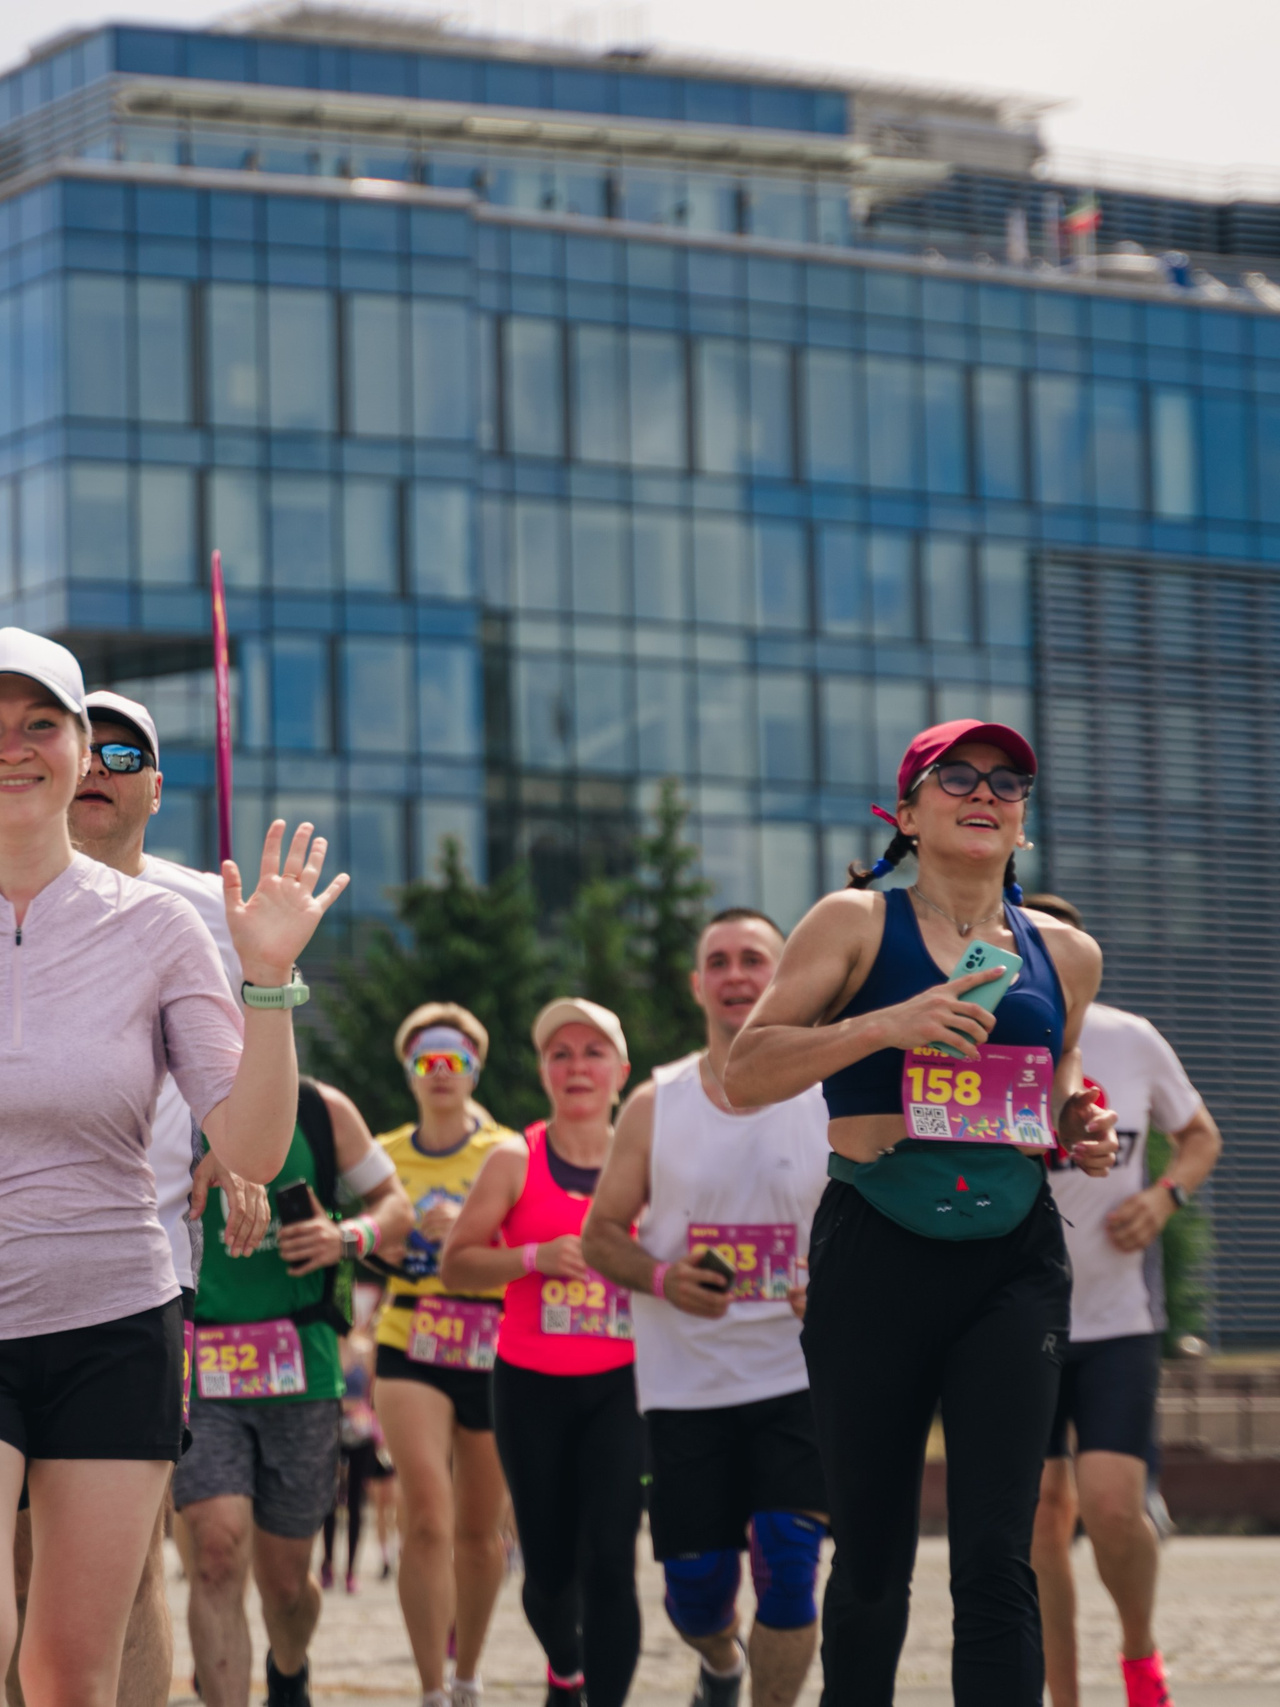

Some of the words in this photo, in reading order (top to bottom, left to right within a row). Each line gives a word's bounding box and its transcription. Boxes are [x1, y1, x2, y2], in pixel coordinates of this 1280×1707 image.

[907, 1067, 982, 1106] 158
[1022, 1070, 1035, 1082] 3
[541, 1279, 606, 1309] 092
[414, 1312, 465, 1342] 041
[199, 1344, 259, 1372] 252
